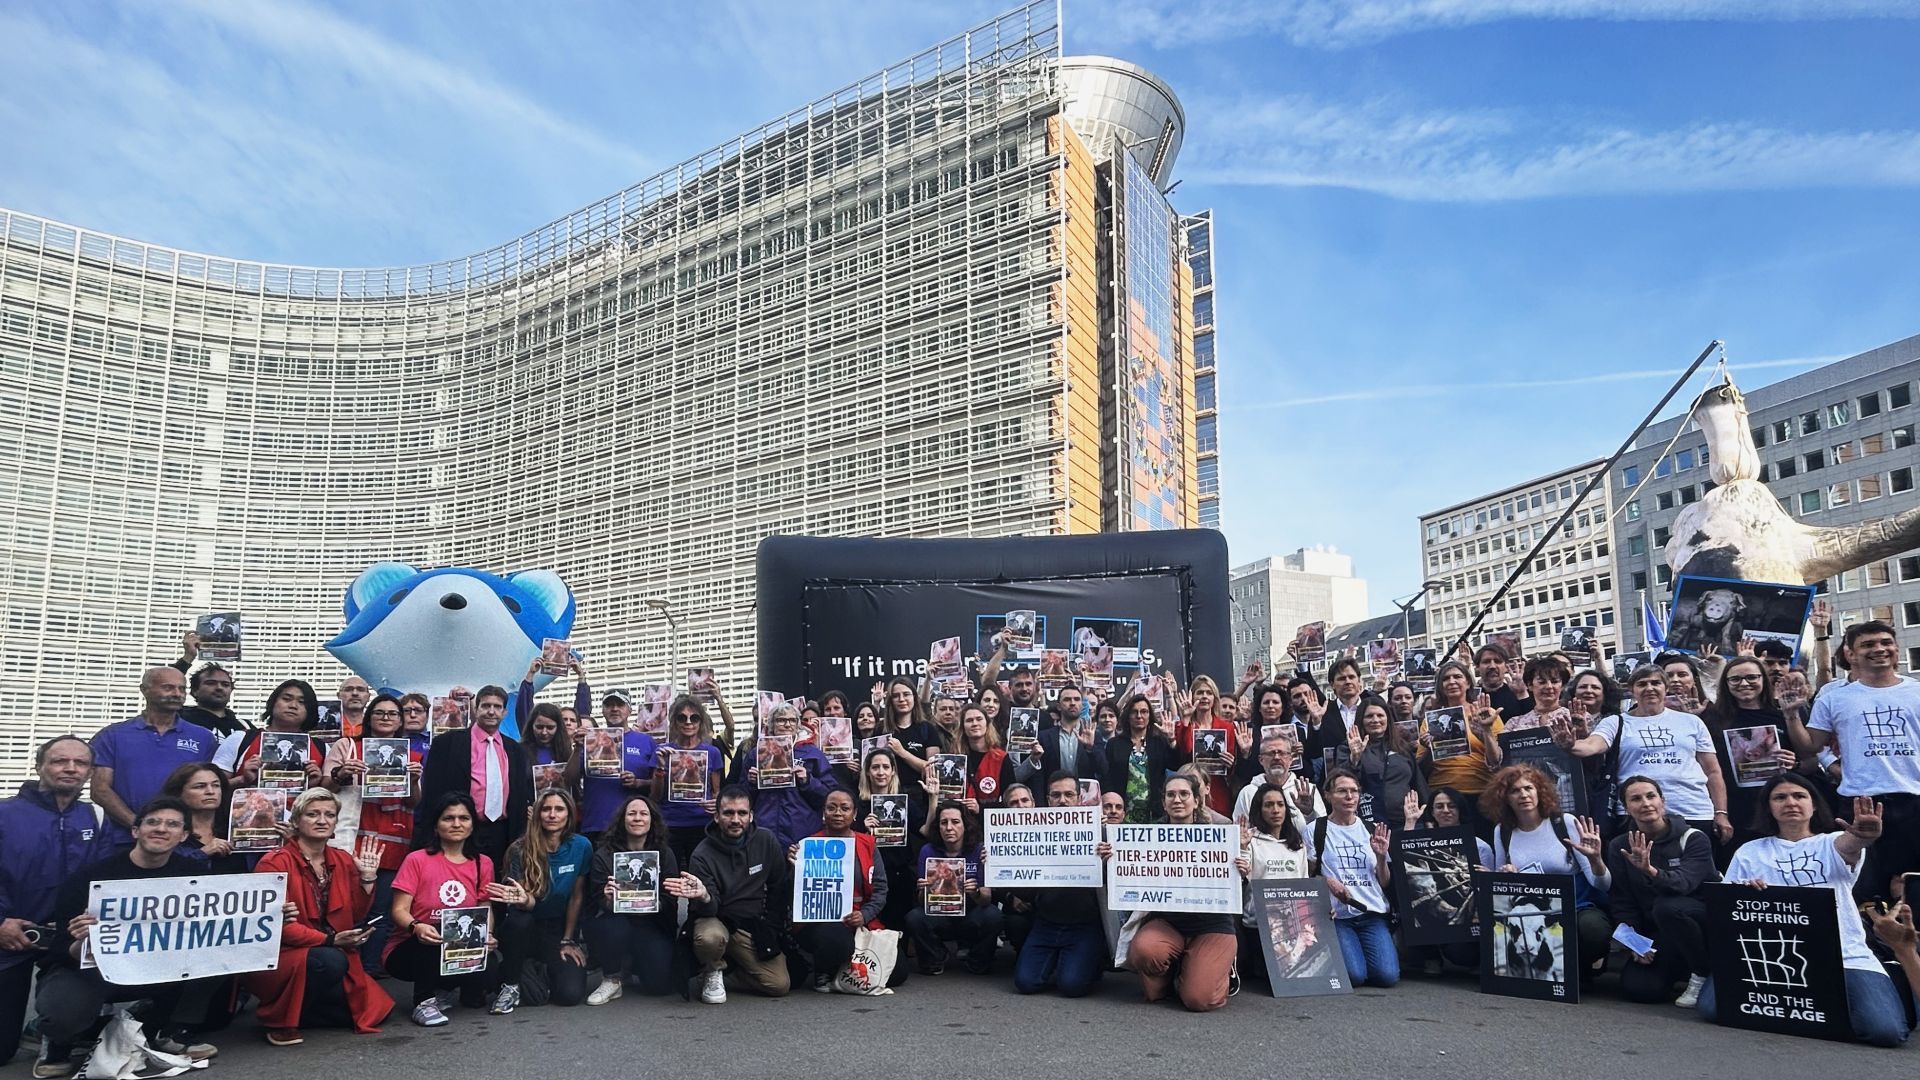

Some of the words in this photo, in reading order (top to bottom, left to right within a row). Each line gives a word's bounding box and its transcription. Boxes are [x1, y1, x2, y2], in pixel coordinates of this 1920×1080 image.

[831, 655, 862, 677] "If
[868, 655, 885, 676] it
[990, 811, 1094, 826] QUALTRANSPORTE
[990, 831, 1041, 843] VERLETZEN
[1044, 831, 1071, 842] TIERE
[1074, 830, 1094, 842] UND
[1116, 827, 1153, 842] JETZT
[1157, 827, 1227, 843] BEENDEN!
[1430, 839, 1449, 847] CAGE
[1449, 838, 1464, 846] AGE
[803, 839, 847, 860] NO
[990, 845, 1058, 857] MENSCHLICHE
[1060, 844, 1094, 856] WERTE
[1116, 849, 1197, 863] TIER-EXPORTE
[1200, 850, 1229, 864] SIND
[803, 859, 845, 878] ANIMAL
[1014, 869, 1042, 880] AWF
[1116, 863, 1160, 877] QUÄLEND
[1163, 866, 1184, 878] UND
[1186, 864, 1230, 879] TÖDLICH
[802, 878, 845, 892] LEFT
[1523, 887, 1544, 895] CAGE
[1545, 887, 1561, 895] AGE
[1140, 890, 1173, 904] AWF
[100, 889, 278, 922] EUROGROUP
[801, 891, 843, 920] BEHIND
[1736, 899, 1770, 911] STOP
[1773, 901, 1801, 913] THE
[1731, 911, 1810, 926] SUFFERING
[100, 923, 121, 955] FOR
[122, 914, 275, 954] ANIMALS
[853, 951, 877, 972] FOUR
[1748, 991, 1779, 1005] END
[1783, 995, 1815, 1010] THE
[1740, 1003, 1785, 1018] CAGE
[1790, 1009, 1827, 1023] AGE
